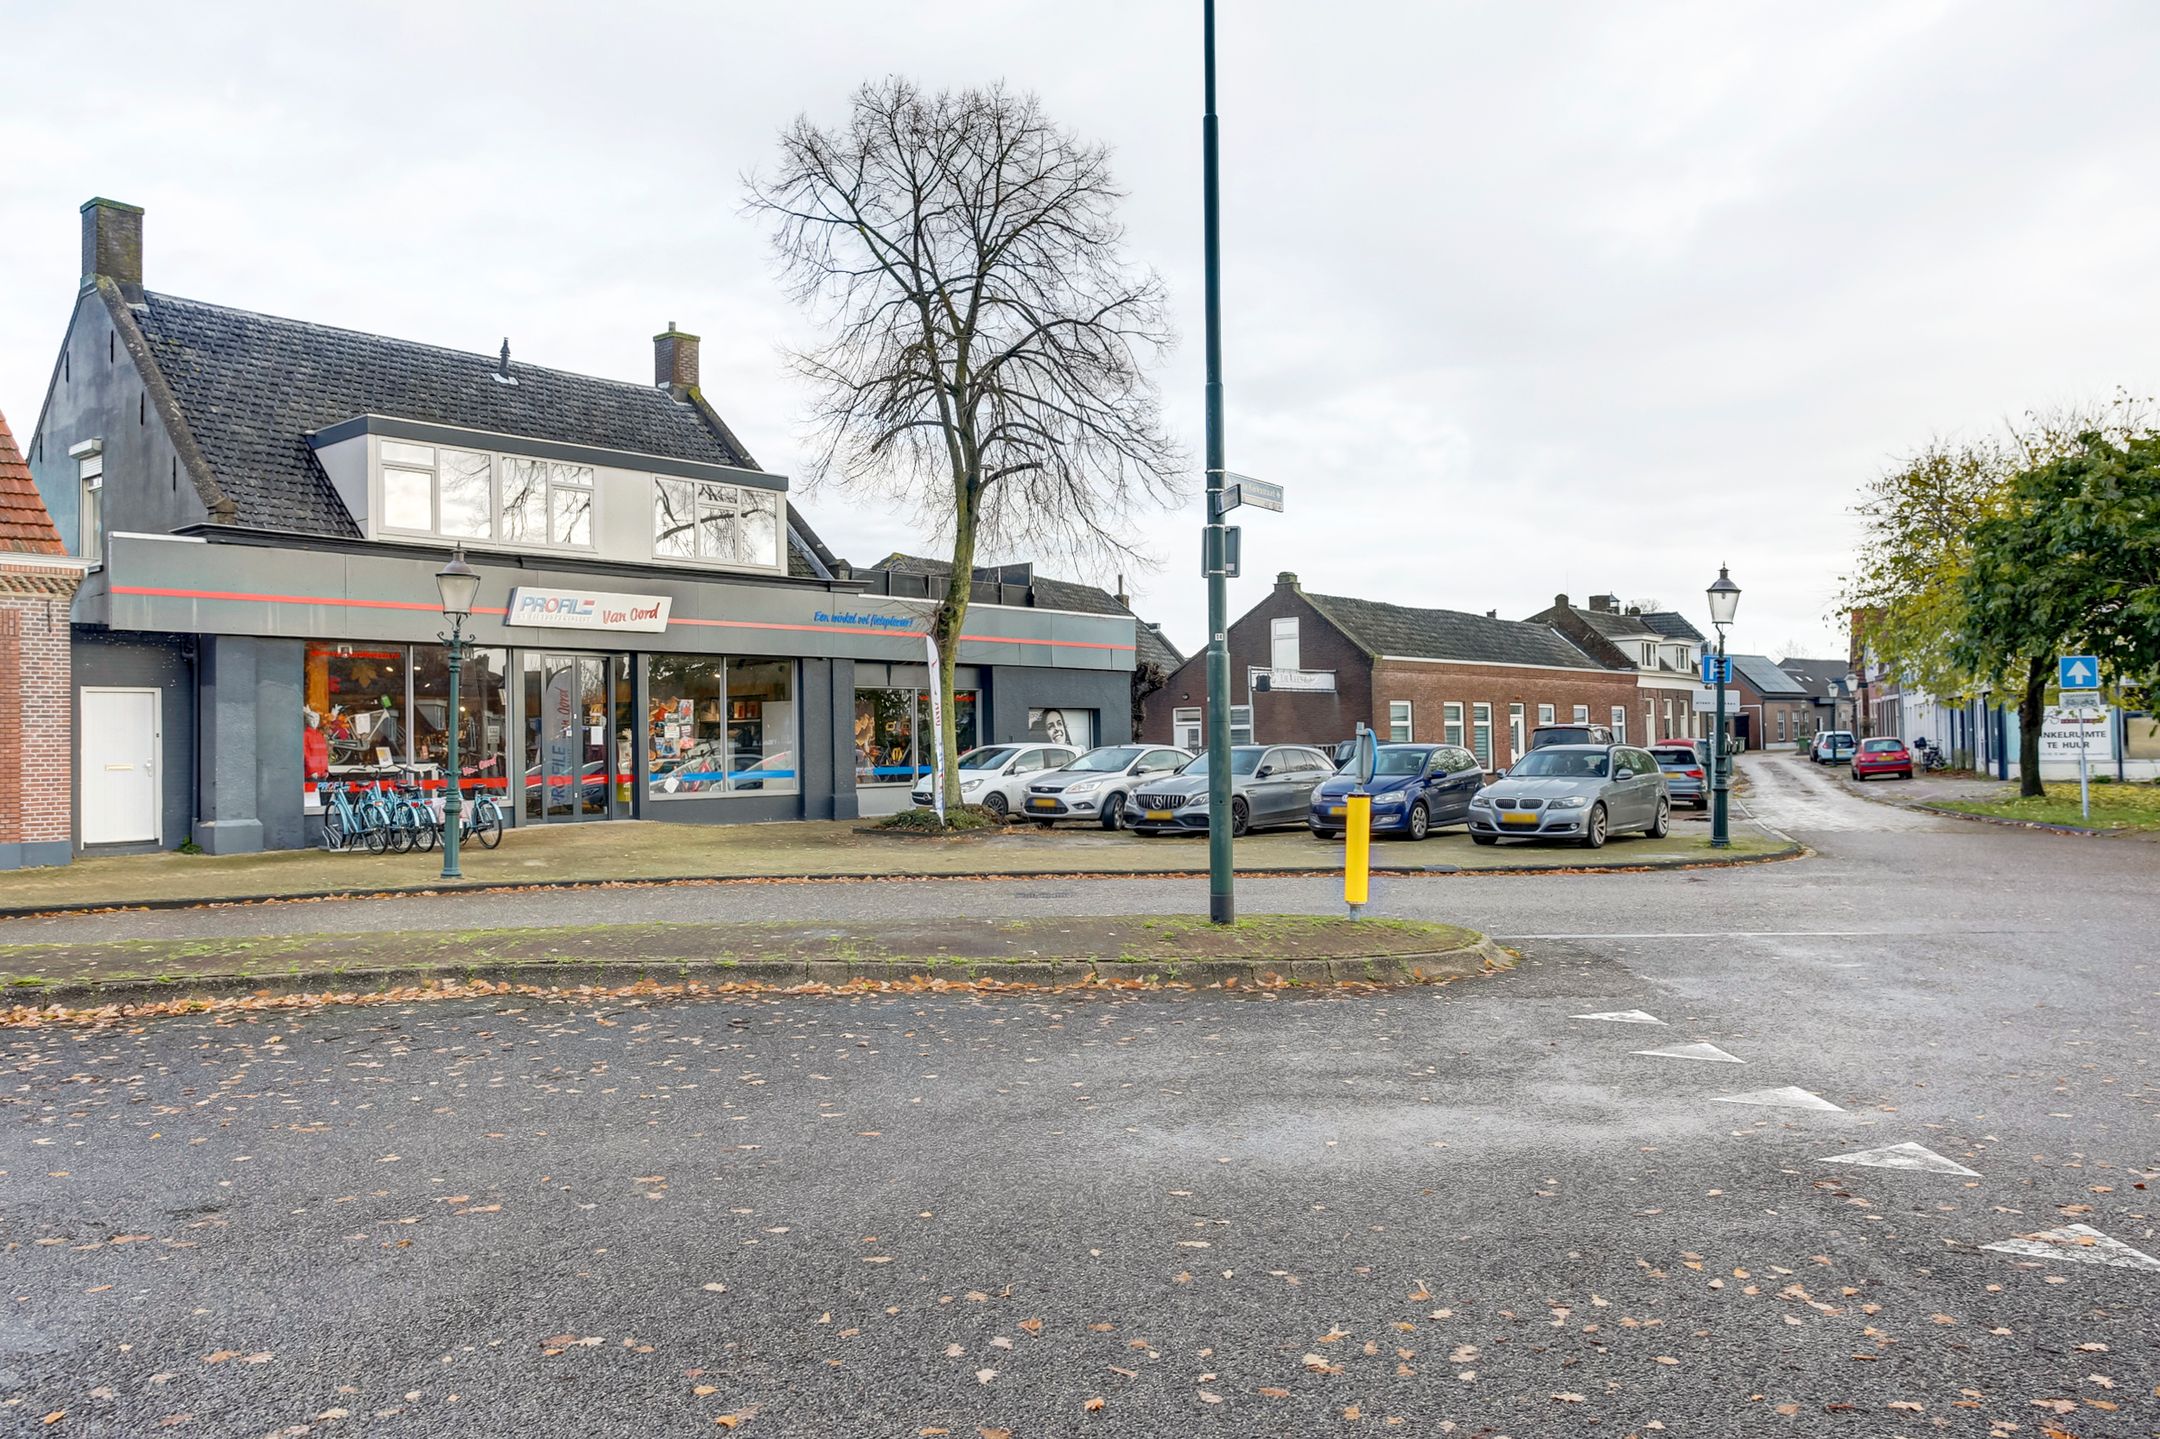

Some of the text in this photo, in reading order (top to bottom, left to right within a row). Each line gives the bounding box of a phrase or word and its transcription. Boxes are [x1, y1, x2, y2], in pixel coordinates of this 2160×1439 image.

[602, 609, 627, 624] Van
[630, 602, 661, 621] Oord
[2041, 730, 2107, 739] NKELRUIMTE
[2046, 741, 2058, 749] TE
